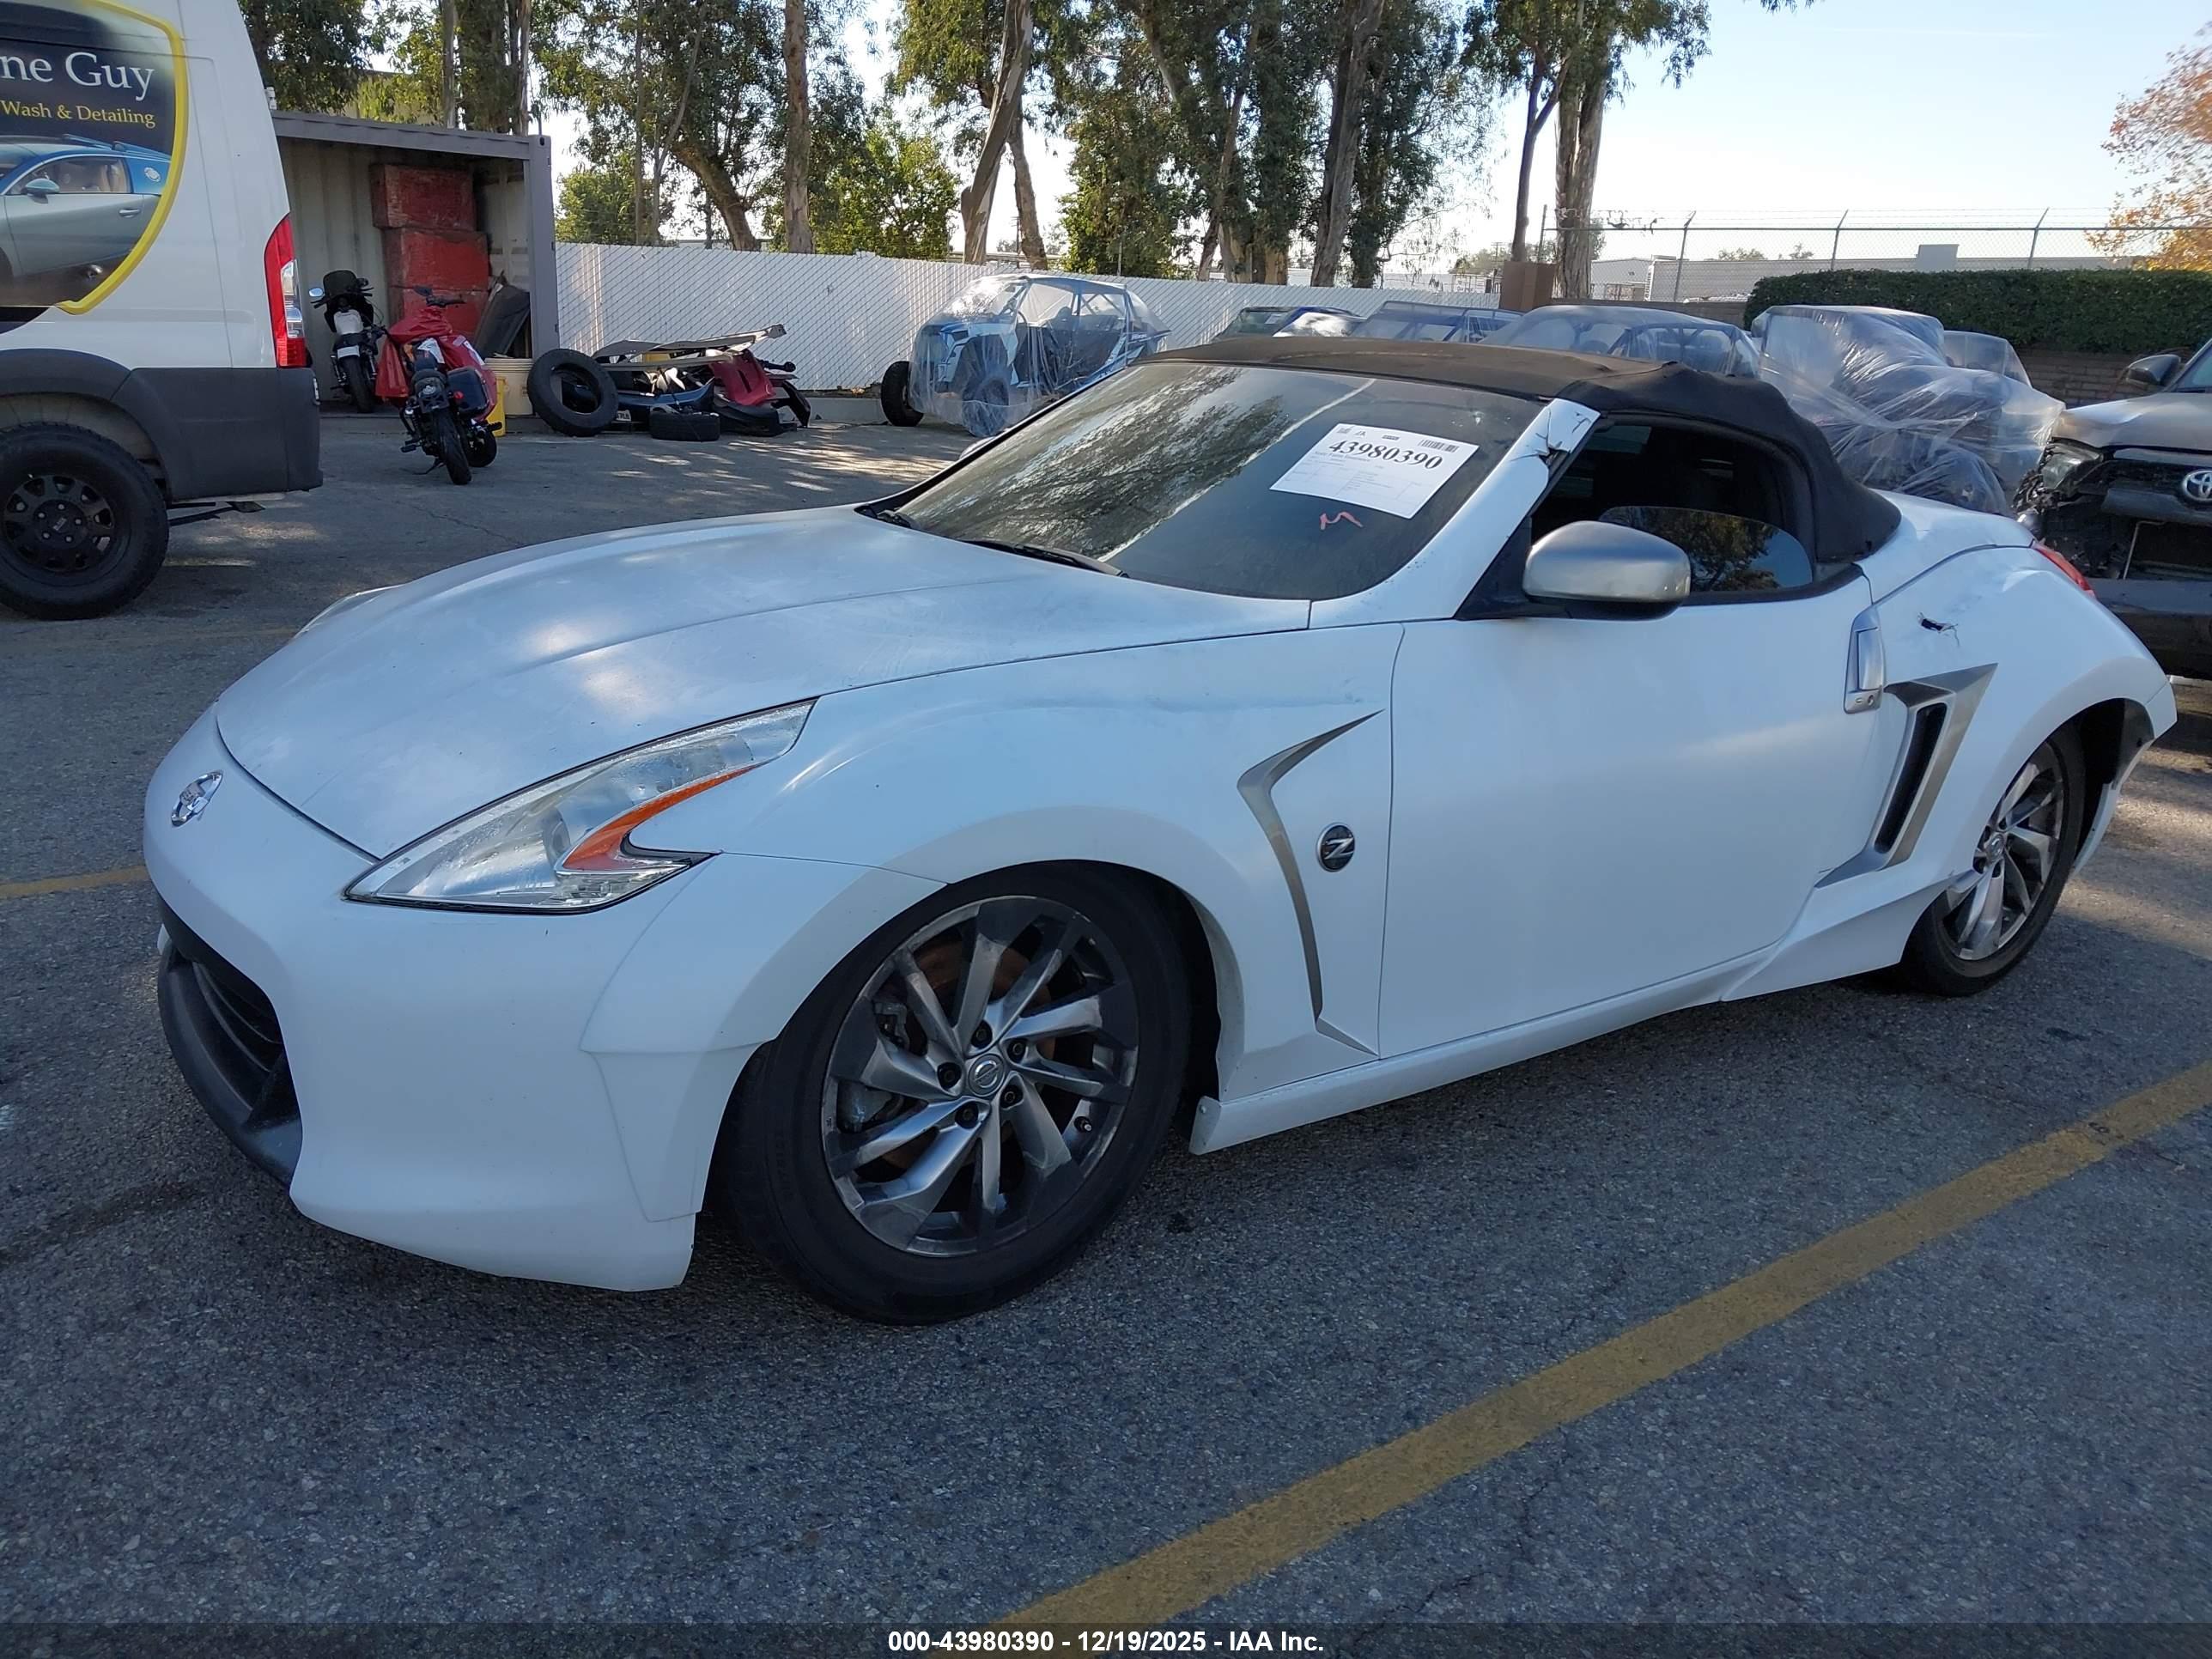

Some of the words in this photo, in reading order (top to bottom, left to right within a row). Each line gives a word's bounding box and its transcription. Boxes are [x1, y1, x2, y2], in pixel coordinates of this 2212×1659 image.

[65, 52, 155, 101] Guy
[0, 100, 52, 118] Wash
[57, 104, 73, 119] &
[76, 105, 156, 129] Detailing
[1328, 440, 1443, 470] 43980390
